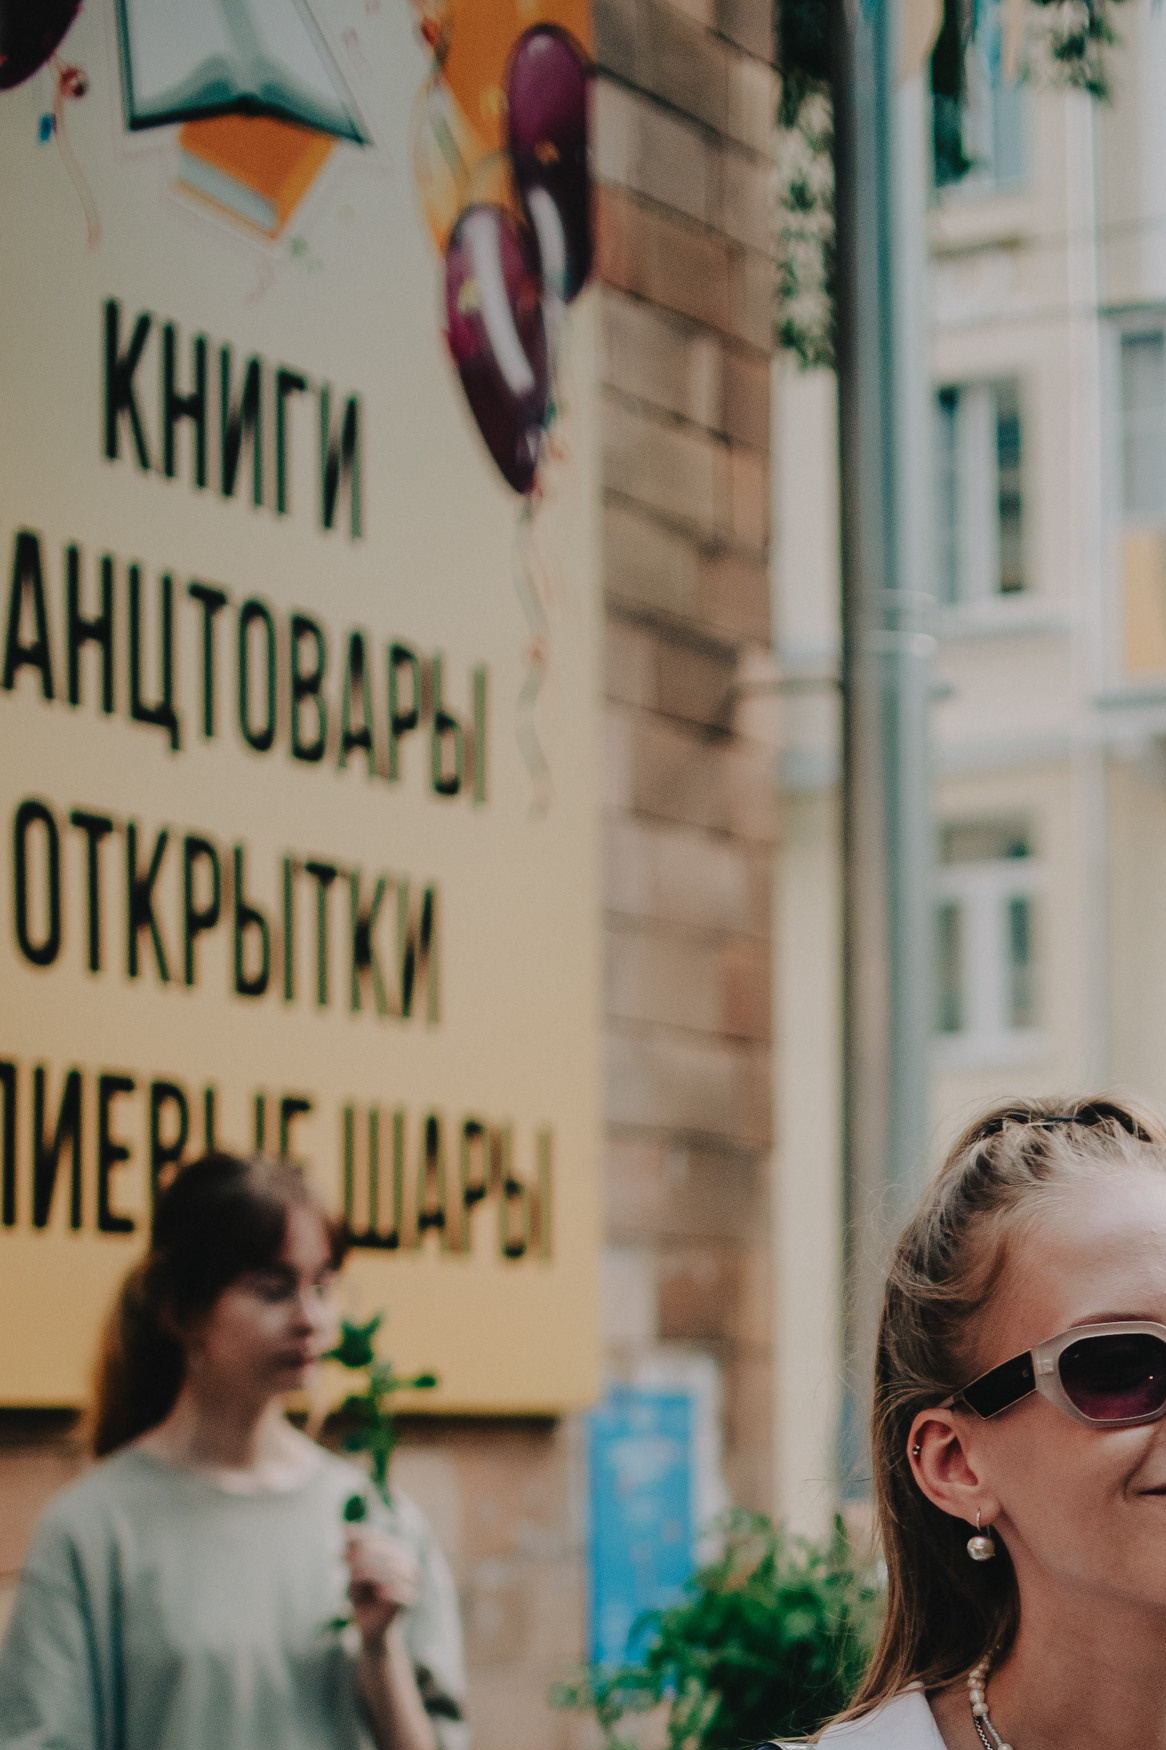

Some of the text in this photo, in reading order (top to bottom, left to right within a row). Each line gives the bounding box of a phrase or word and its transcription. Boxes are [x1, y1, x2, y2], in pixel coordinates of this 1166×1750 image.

[104, 297, 362, 541] КНИГИ
[1, 529, 488, 808] АНЦТОВАРЫ
[14, 800, 440, 1026] ОТКРЫТКИ
[344, 1105, 554, 1260] ШАРЫ
